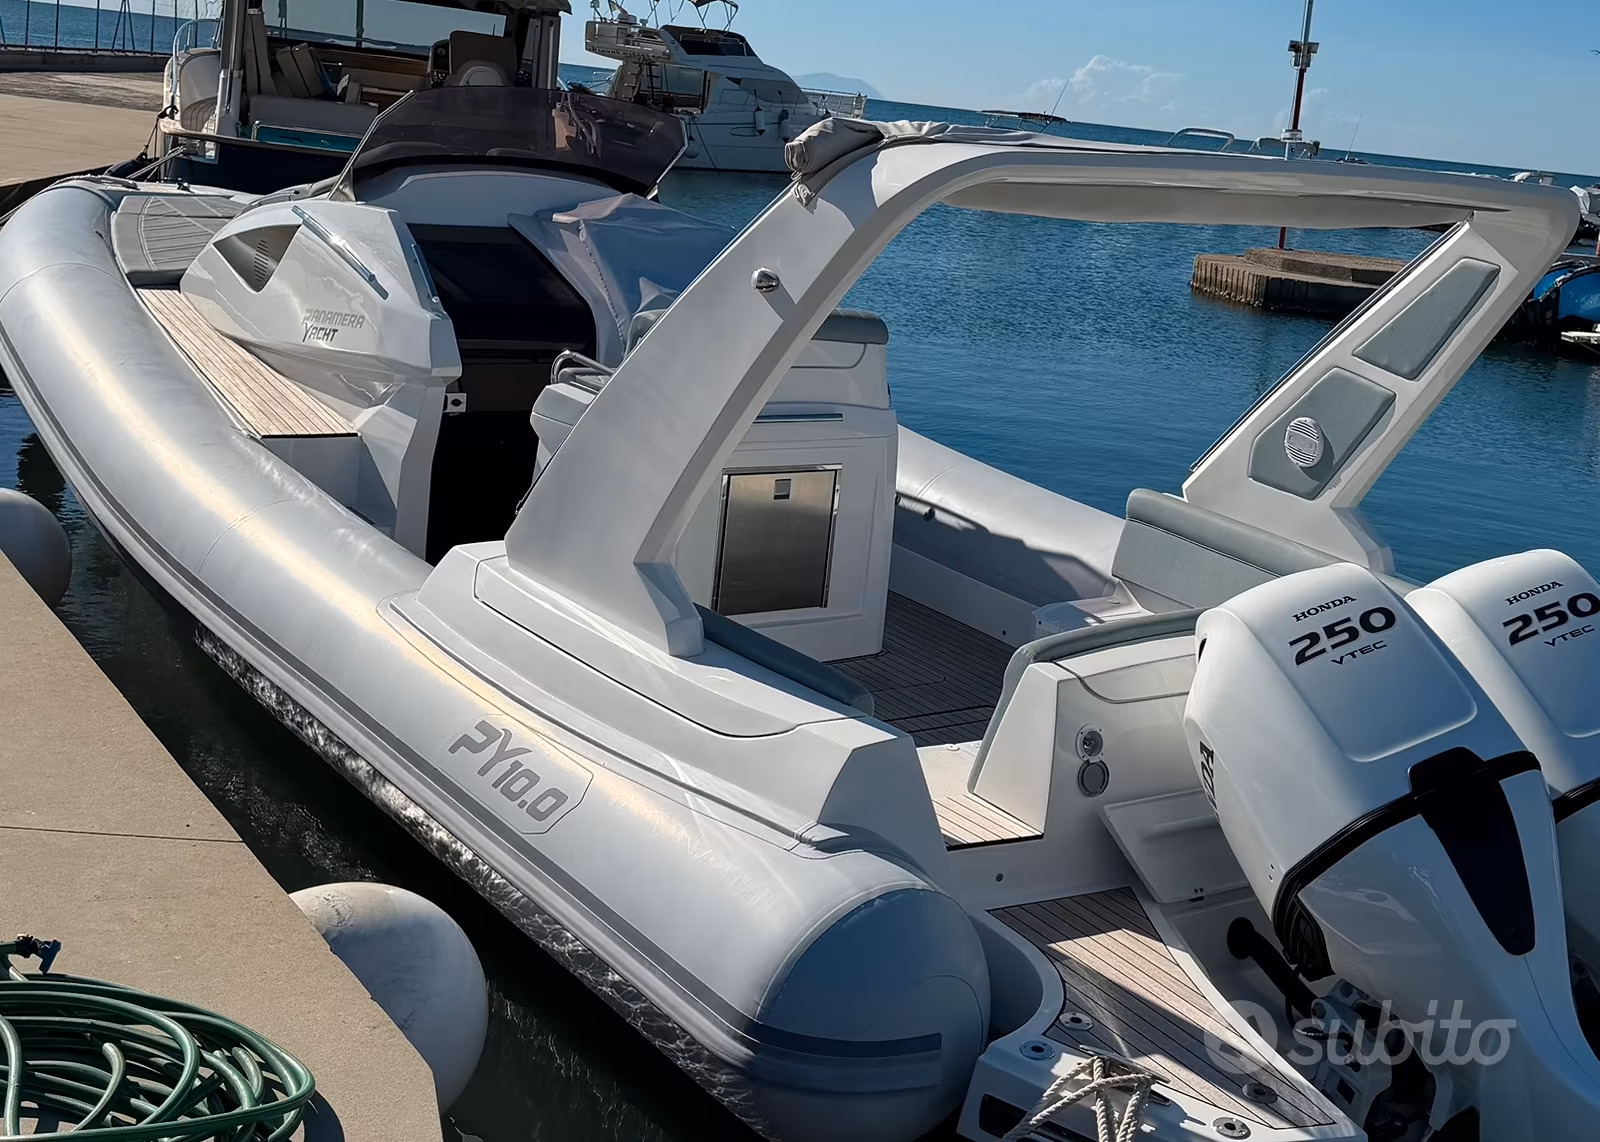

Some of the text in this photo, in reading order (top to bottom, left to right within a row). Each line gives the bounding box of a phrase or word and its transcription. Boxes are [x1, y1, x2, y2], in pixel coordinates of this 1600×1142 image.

[301, 308, 366, 329] PANAMERA
[302, 321, 339, 343] YACHT
[1504, 581, 1564, 606] HONDA
[1291, 595, 1358, 622] HONDA
[1501, 592, 1600, 647] 250
[1288, 606, 1396, 667] 250
[1543, 624, 1596, 647] VTEC
[1330, 640, 1388, 665] VTEC
[447, 719, 569, 822] PY10.0
